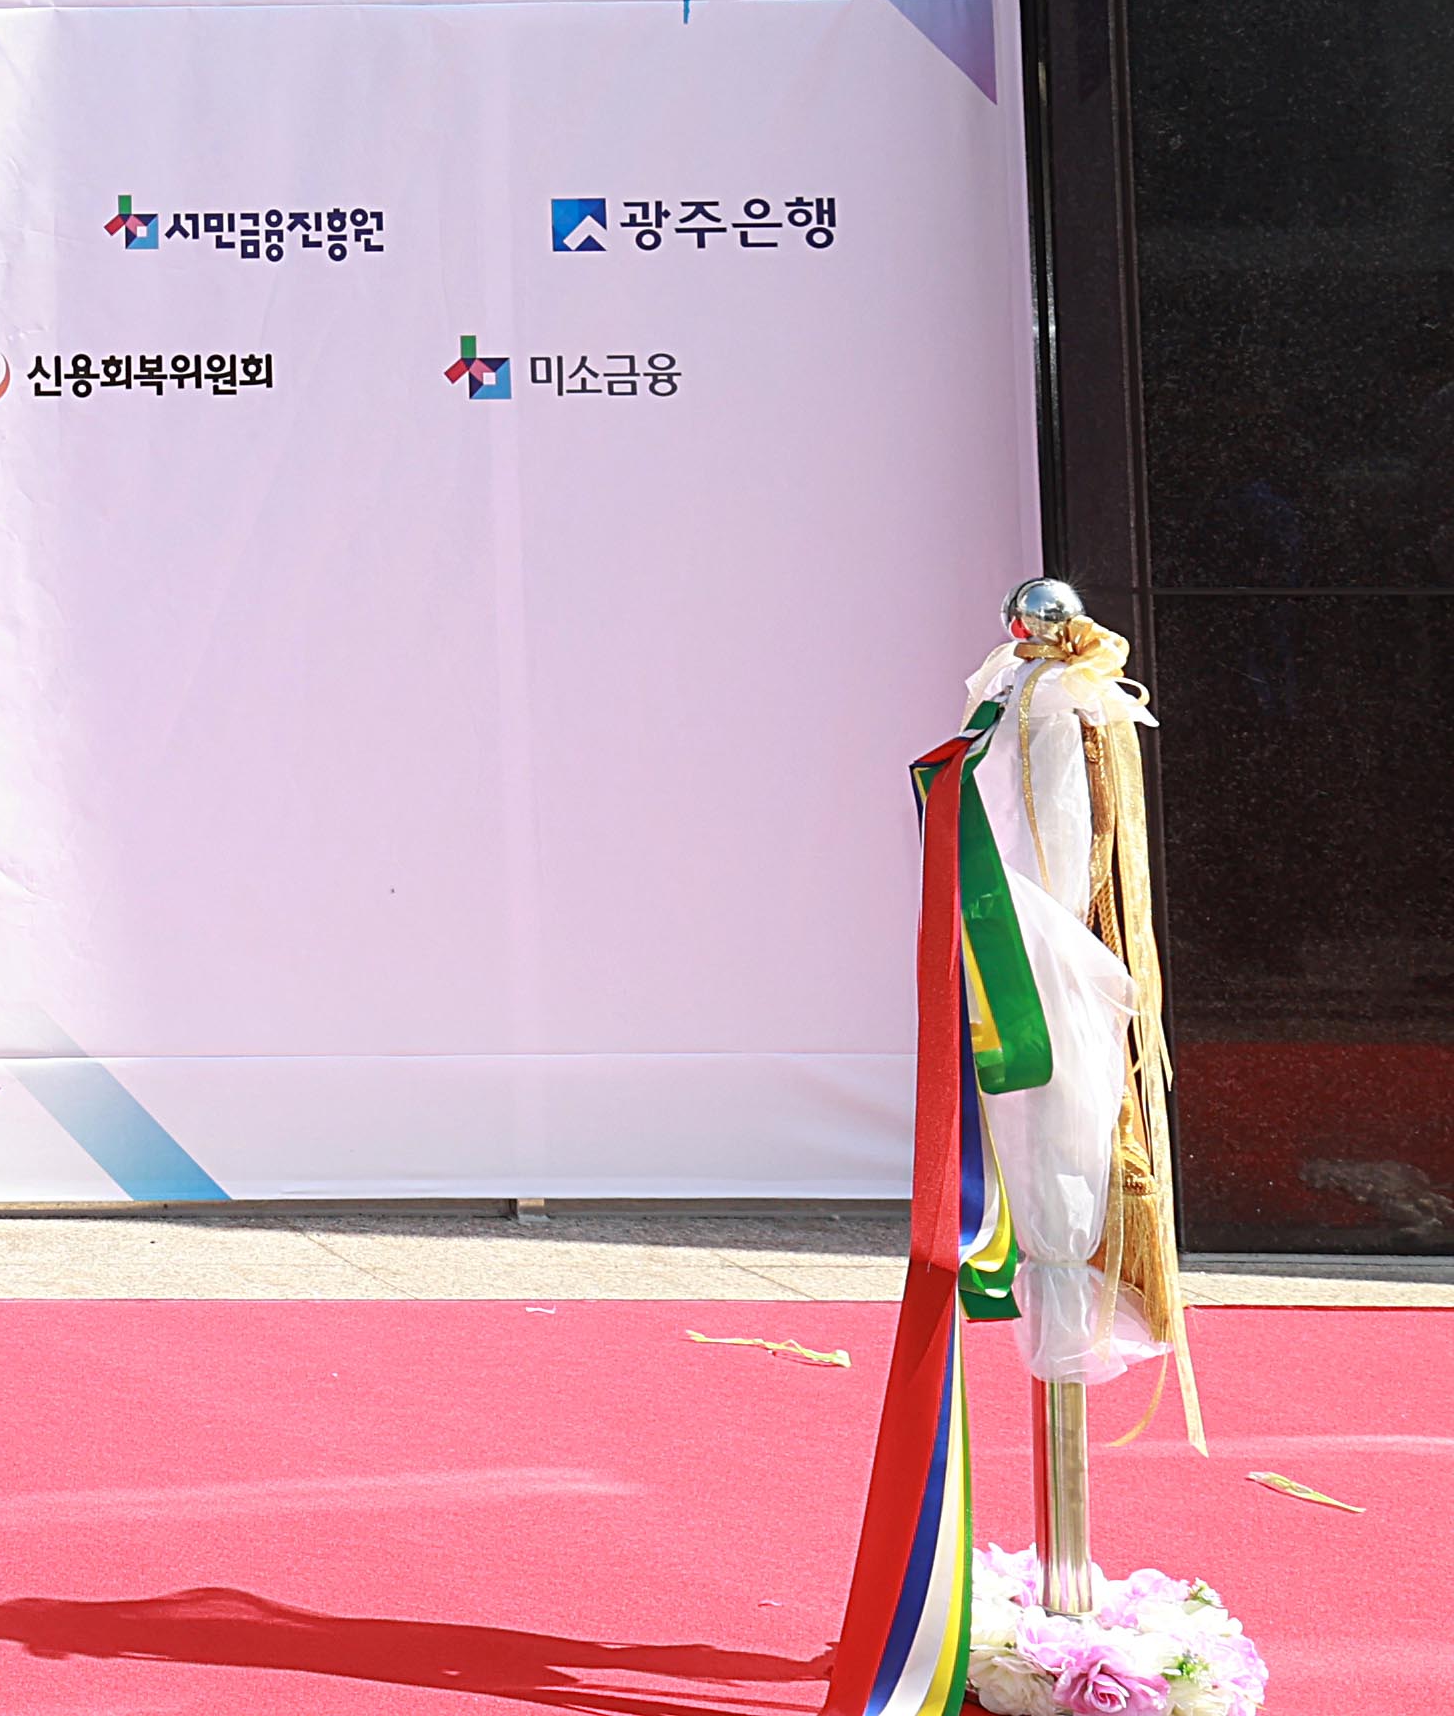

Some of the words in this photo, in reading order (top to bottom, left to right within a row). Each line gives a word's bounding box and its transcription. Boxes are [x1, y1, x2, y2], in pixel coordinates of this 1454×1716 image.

[164, 208, 385, 263] 서민금융진흥원
[619, 196, 838, 251] 광주은행
[26, 353, 274, 398] 신용회복위원회
[529, 352, 683, 397] 미소금융
